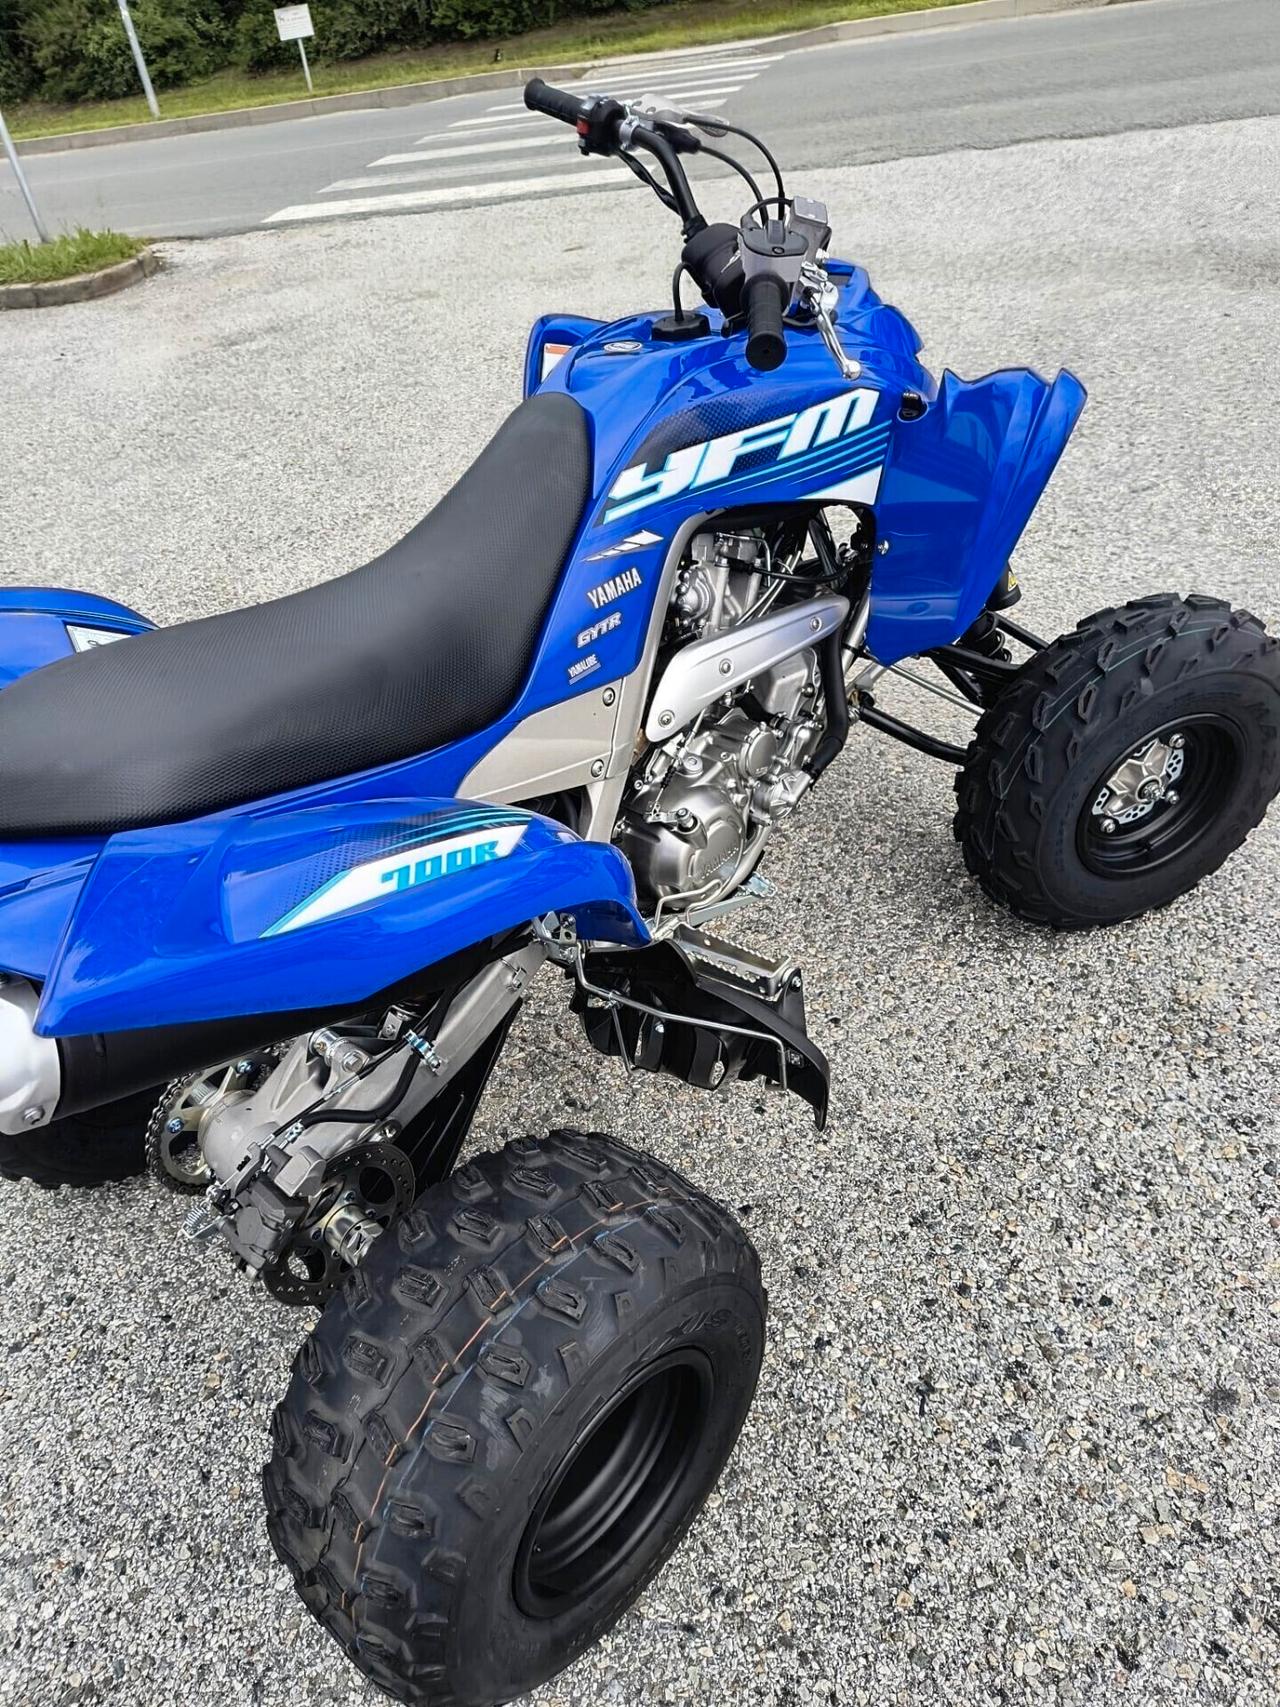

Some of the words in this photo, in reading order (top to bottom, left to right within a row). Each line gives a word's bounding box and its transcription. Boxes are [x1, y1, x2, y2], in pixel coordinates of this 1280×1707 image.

[603, 387, 880, 525] YFM
[587, 567, 642, 609] YAMAHA
[577, 612, 622, 648] GYTR
[381, 840, 500, 892] 700R
